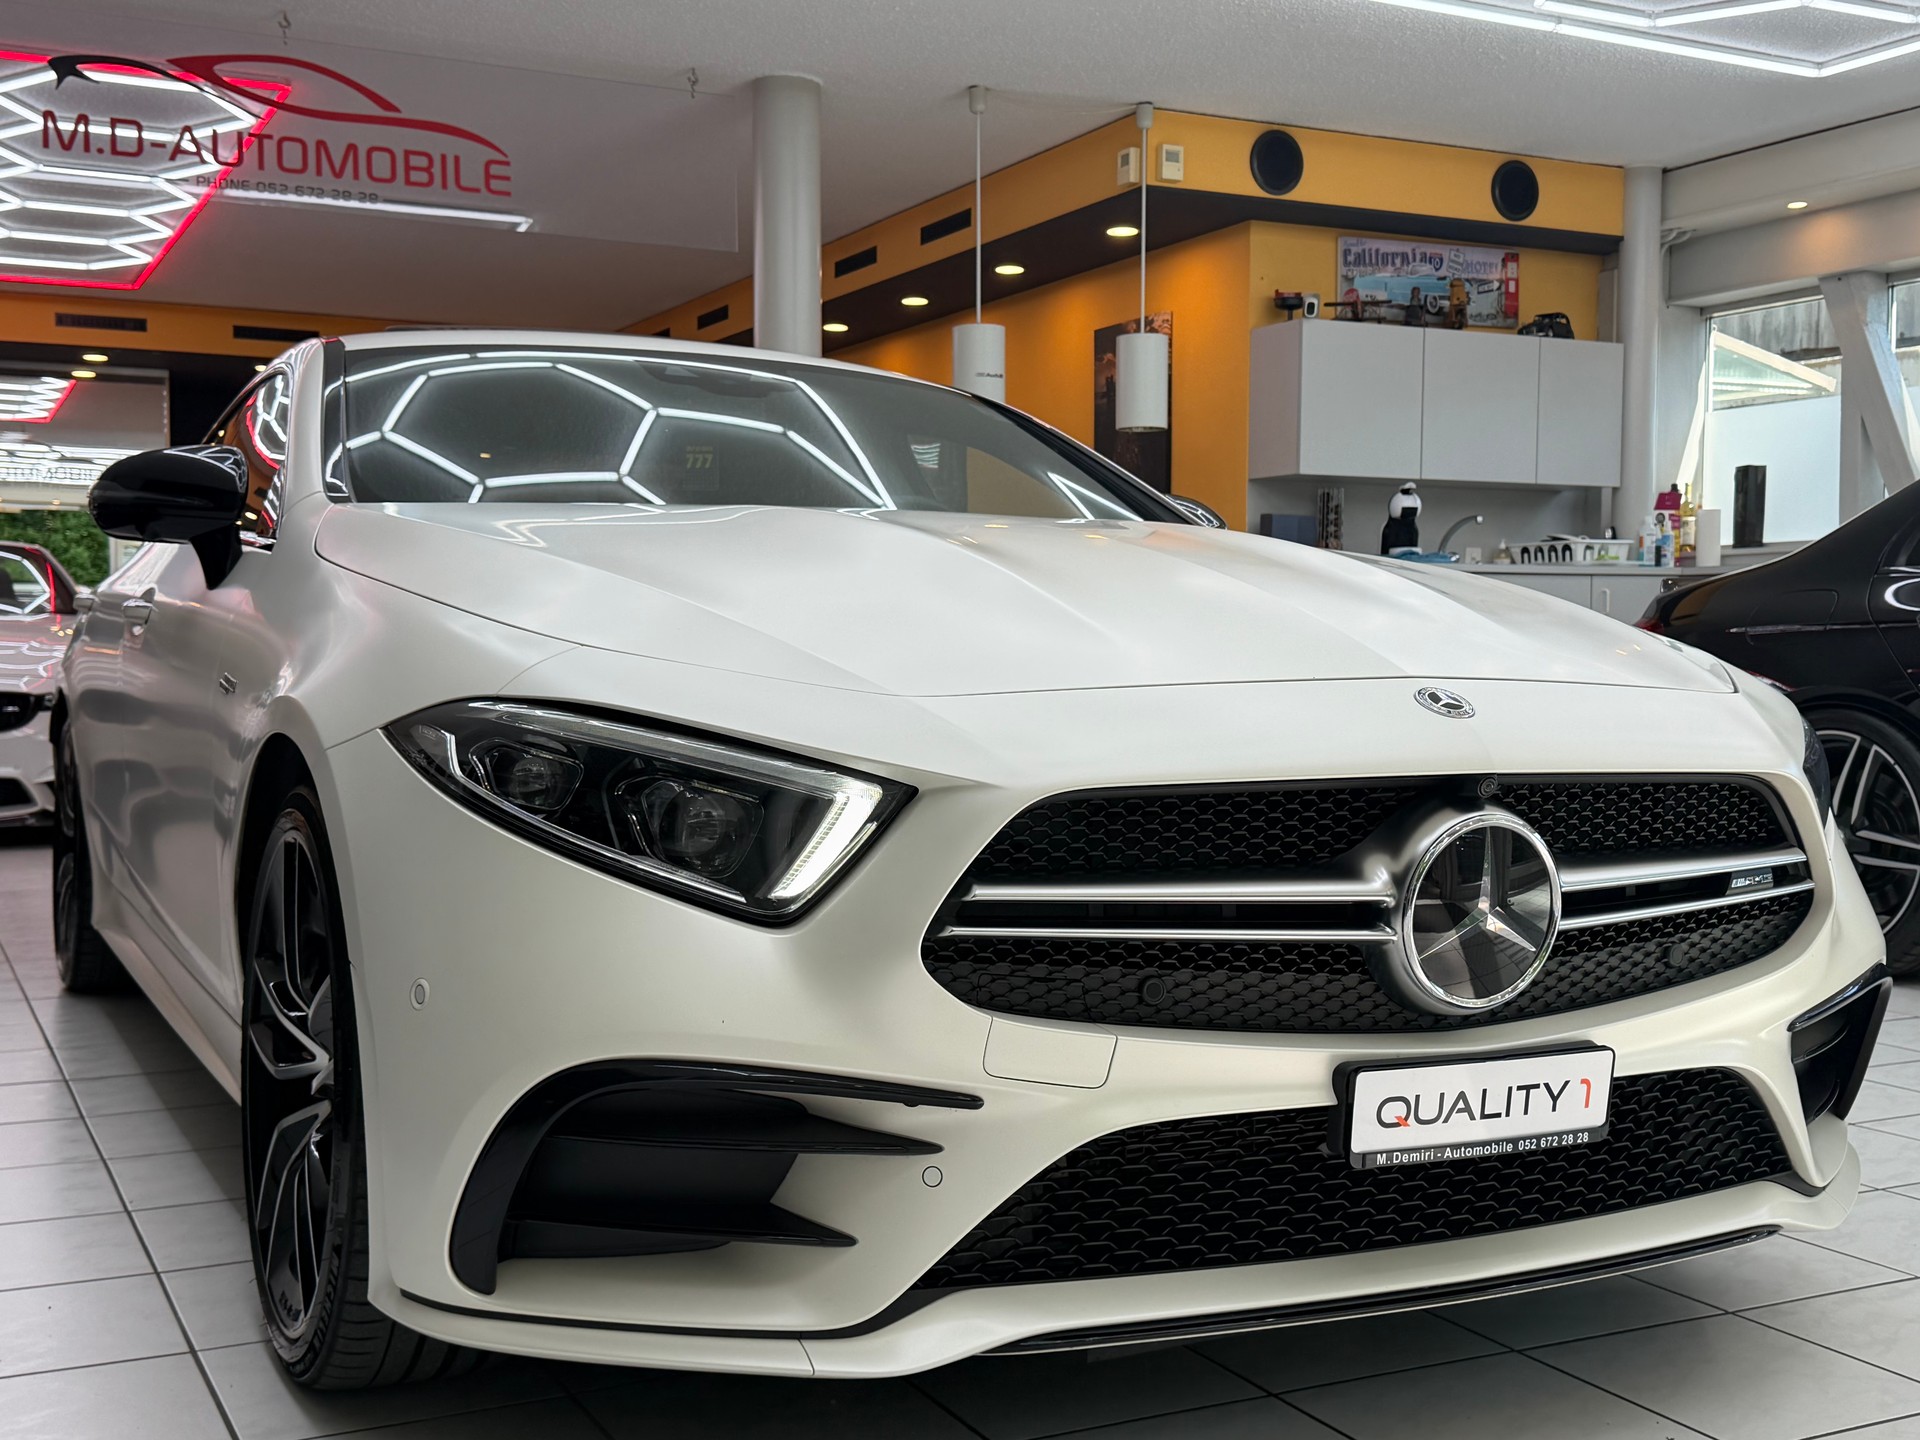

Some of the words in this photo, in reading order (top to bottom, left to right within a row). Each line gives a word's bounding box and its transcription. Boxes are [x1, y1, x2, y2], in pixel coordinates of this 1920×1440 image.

[41, 110, 512, 197] M.D-AUTOMOBILE
[195, 175, 251, 190] PHONE
[256, 181, 290, 195] 052
[295, 185, 325, 199] 672
[1376, 1080, 1571, 1129] QUALITY
[1580, 1078, 1592, 1109] 1
[1393, 1148, 1435, 1163] Demiri
[1444, 1141, 1514, 1159] Automobile
[1518, 1138, 1537, 1151] 052
[1540, 1135, 1559, 1148] 672
[1562, 1133, 1574, 1145] 28
[1577, 1131, 1589, 1143] 28
